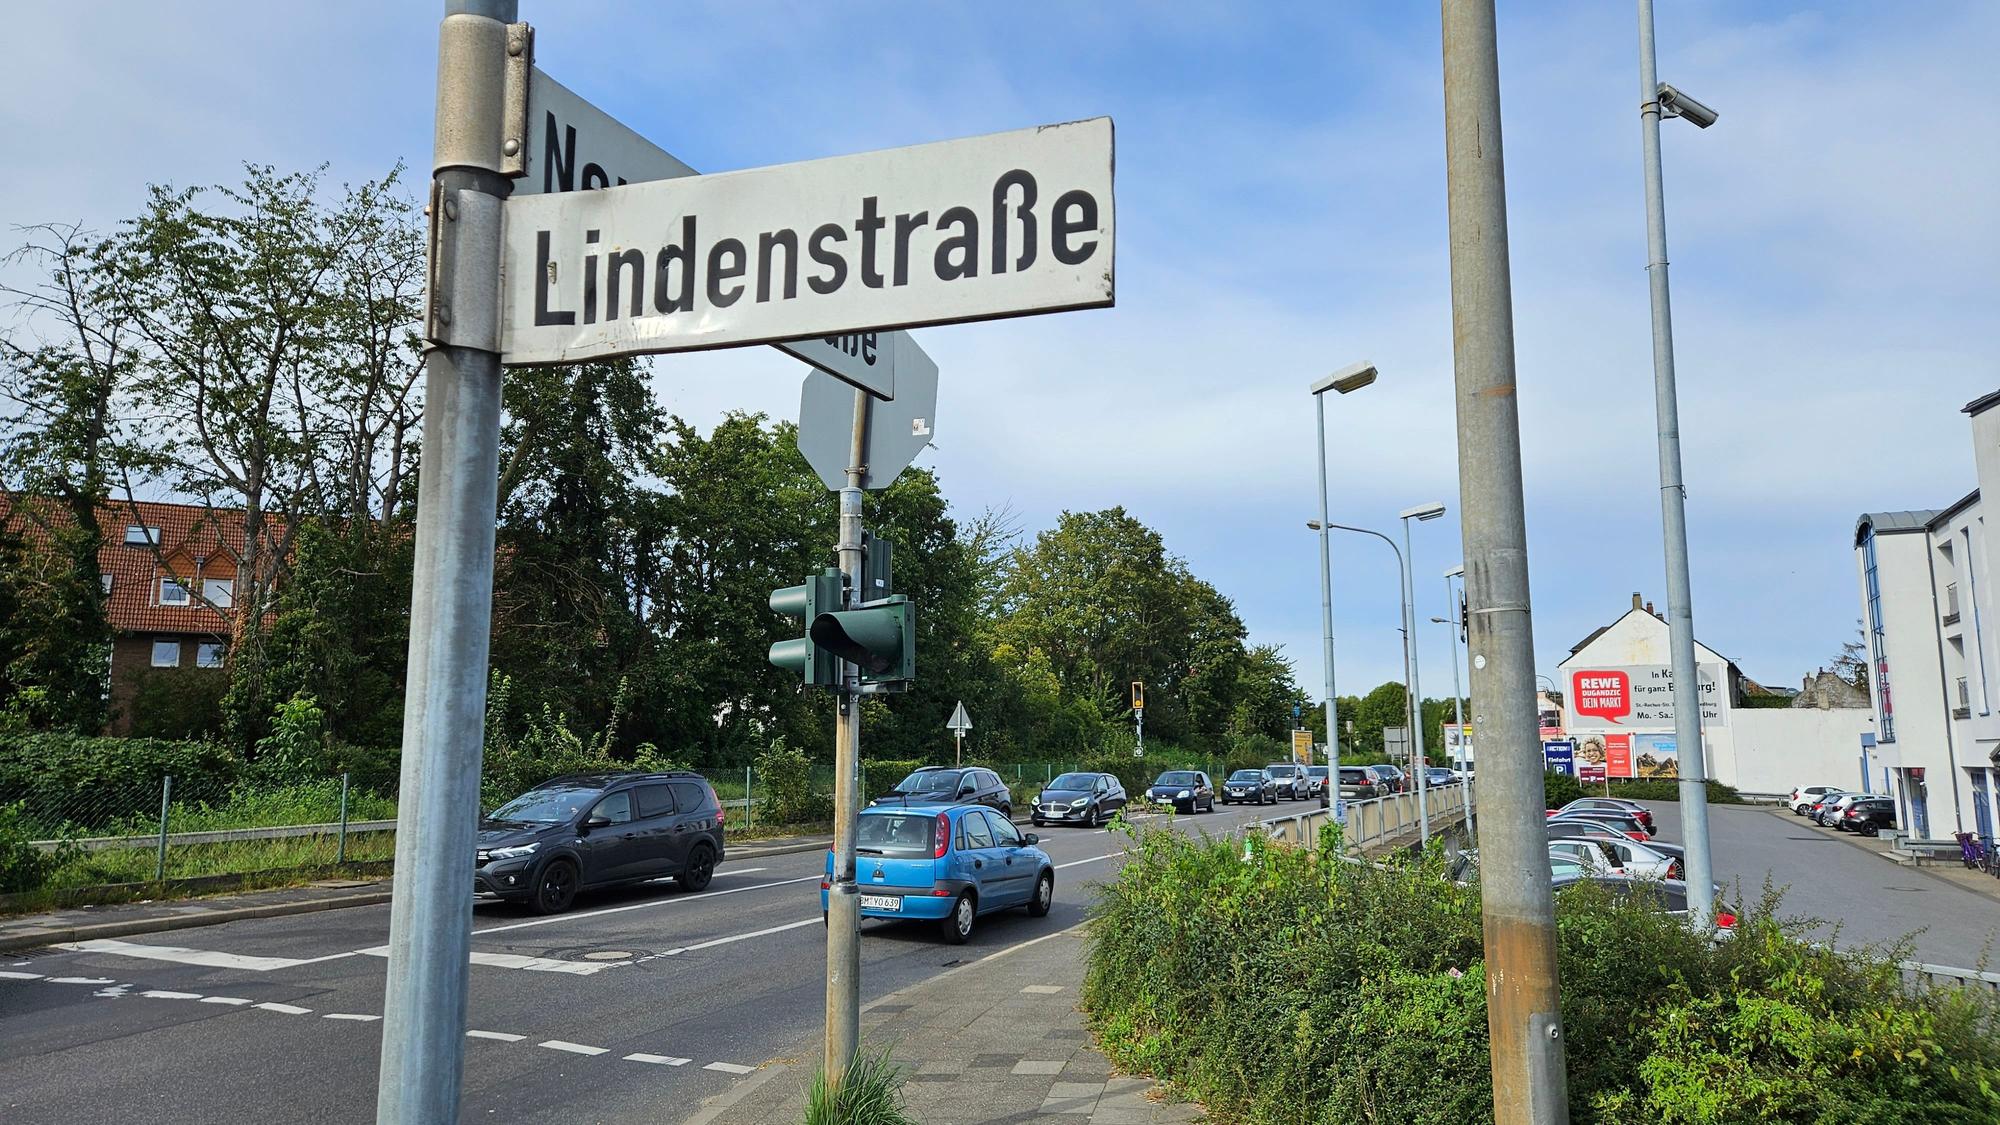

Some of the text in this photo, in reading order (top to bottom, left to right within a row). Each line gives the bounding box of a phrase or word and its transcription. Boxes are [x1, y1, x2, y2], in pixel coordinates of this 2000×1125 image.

[534, 168, 1098, 326] Lindenstraße
[1661, 669, 1673, 678] Ka
[1581, 678, 1621, 688] REWE
[1647, 686, 1666, 694] ganz
[1583, 698, 1621, 708] DEIN MARKT
[884, 899, 899, 908] 639
